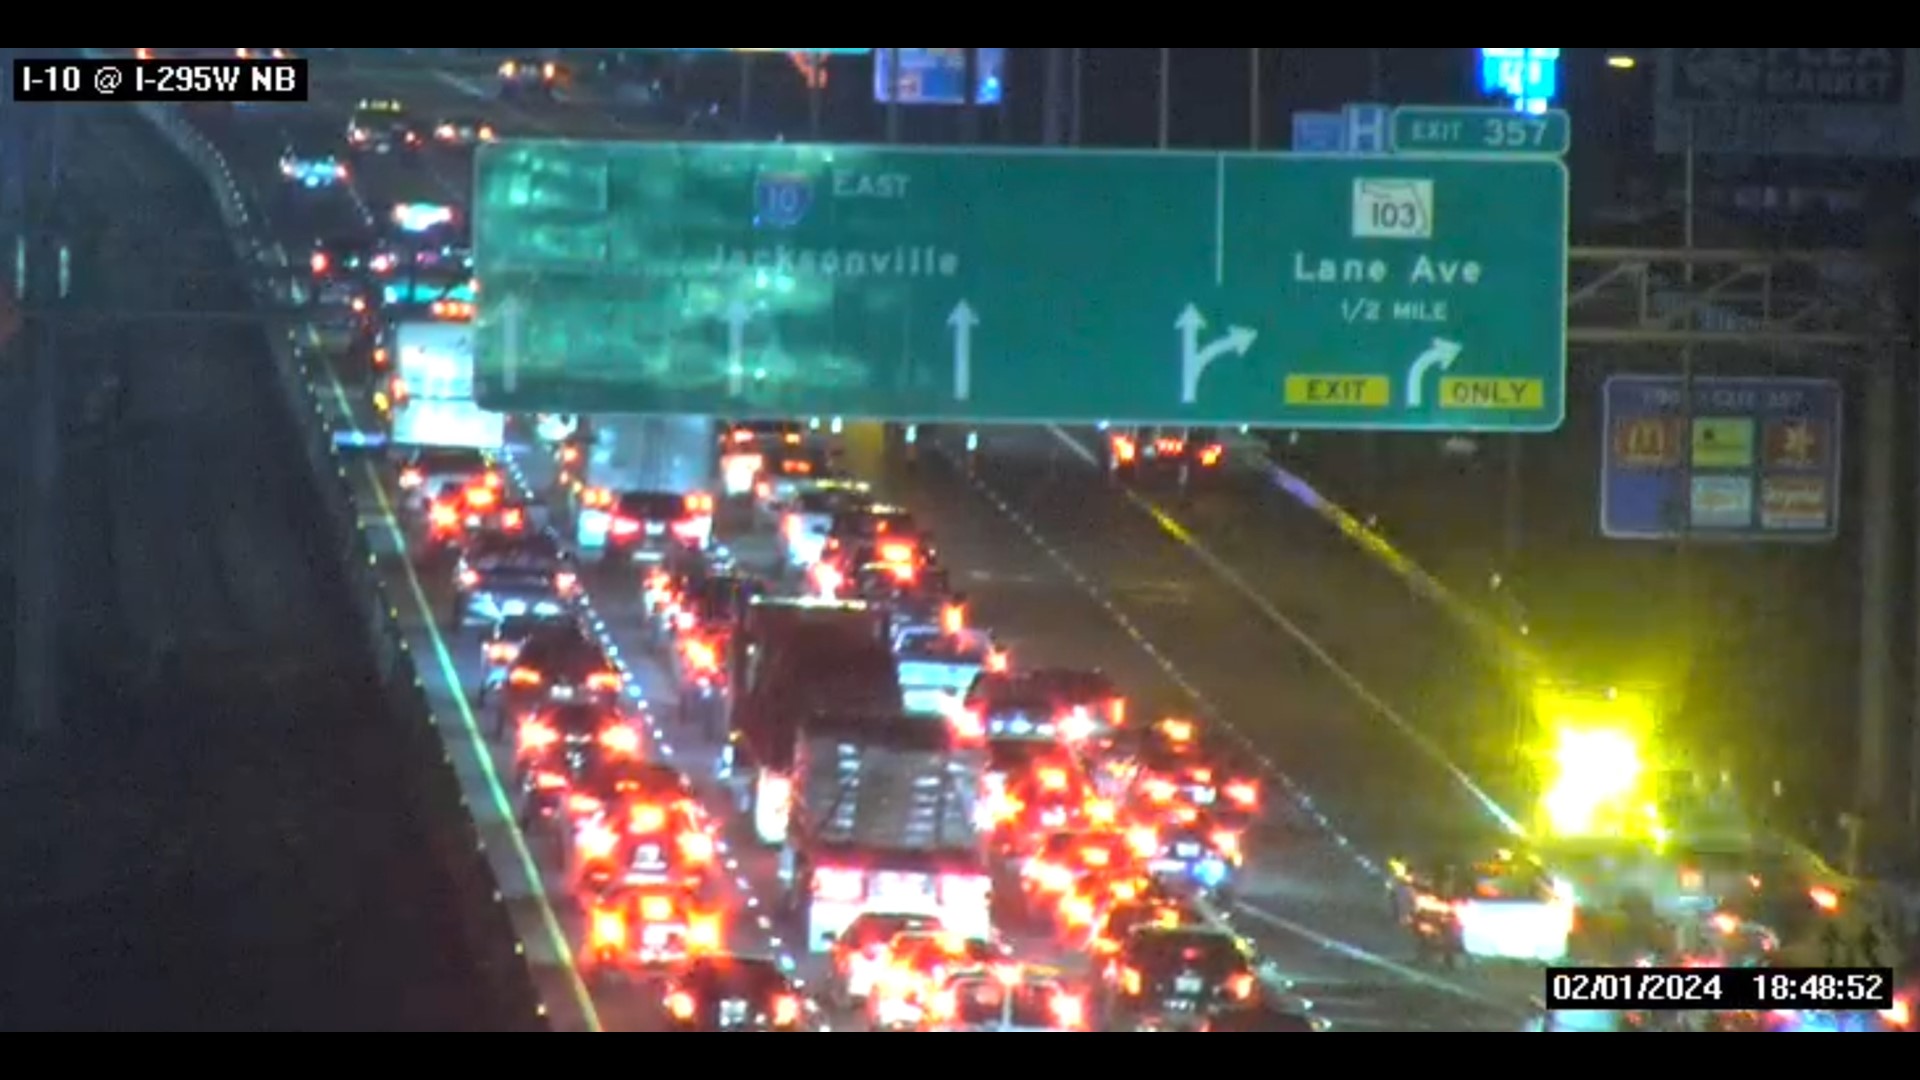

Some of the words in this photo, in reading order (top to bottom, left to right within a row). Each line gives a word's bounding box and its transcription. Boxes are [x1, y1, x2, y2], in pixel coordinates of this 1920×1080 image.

[1411, 120, 1461, 142] EXIT
[1483, 119, 1547, 147] 357
[831, 173, 911, 199] EAST
[765, 187, 799, 214] 10
[1372, 203, 1416, 228] 103
[708, 245, 960, 276] Jacksonville
[1294, 252, 1388, 283] Lane
[1410, 256, 1482, 284] Ave
[1341, 299, 1380, 322] 1/2
[1393, 301, 1449, 322] MILE
[1306, 379, 1367, 401] EXIT
[1452, 383, 1527, 405] ONLY
